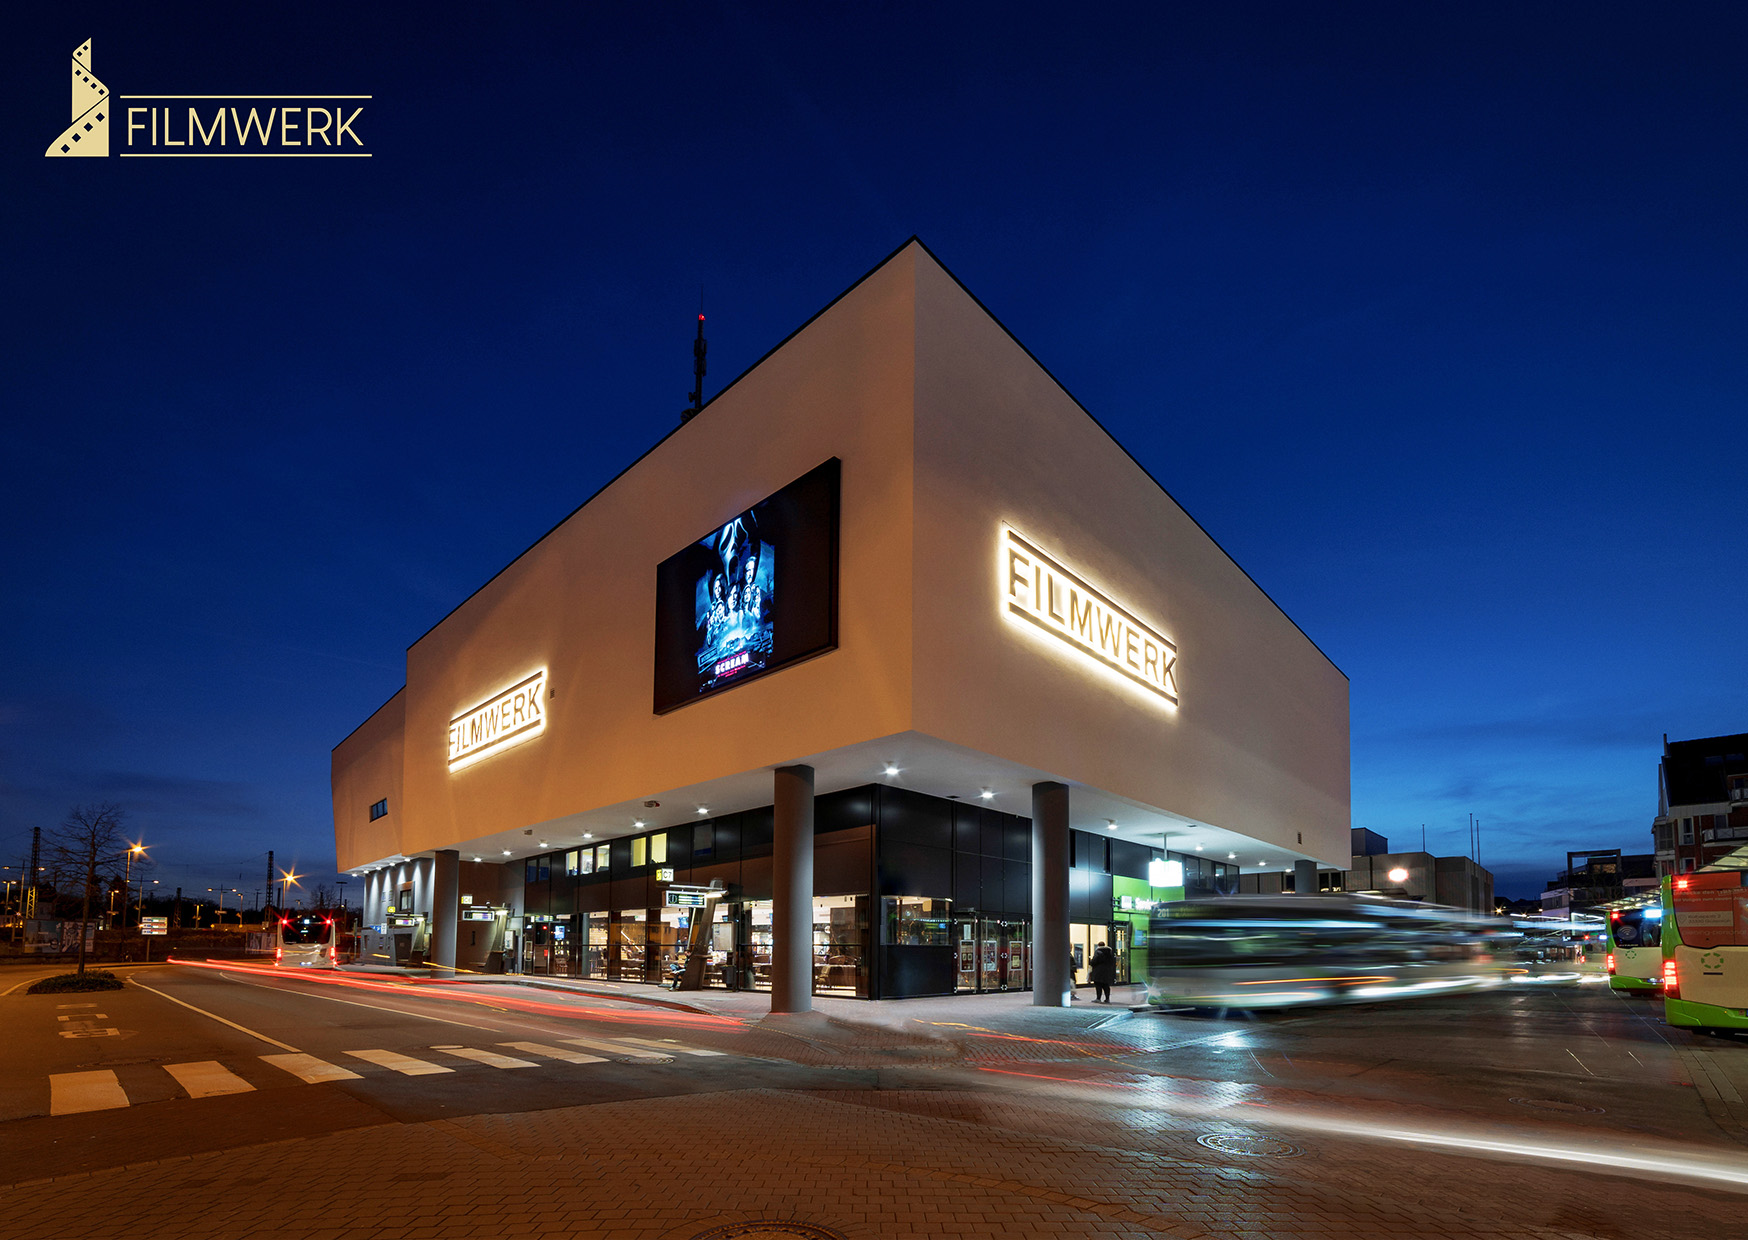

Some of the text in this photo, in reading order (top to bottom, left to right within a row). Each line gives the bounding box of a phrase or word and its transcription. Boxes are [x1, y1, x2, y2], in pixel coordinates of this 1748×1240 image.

[1008, 547, 1178, 694] FILMWERK
[715, 653, 749, 675] SCREAM
[447, 682, 542, 757] FILMWERK
[663, 870, 672, 879] C7
[1157, 908, 1170, 918] 201
